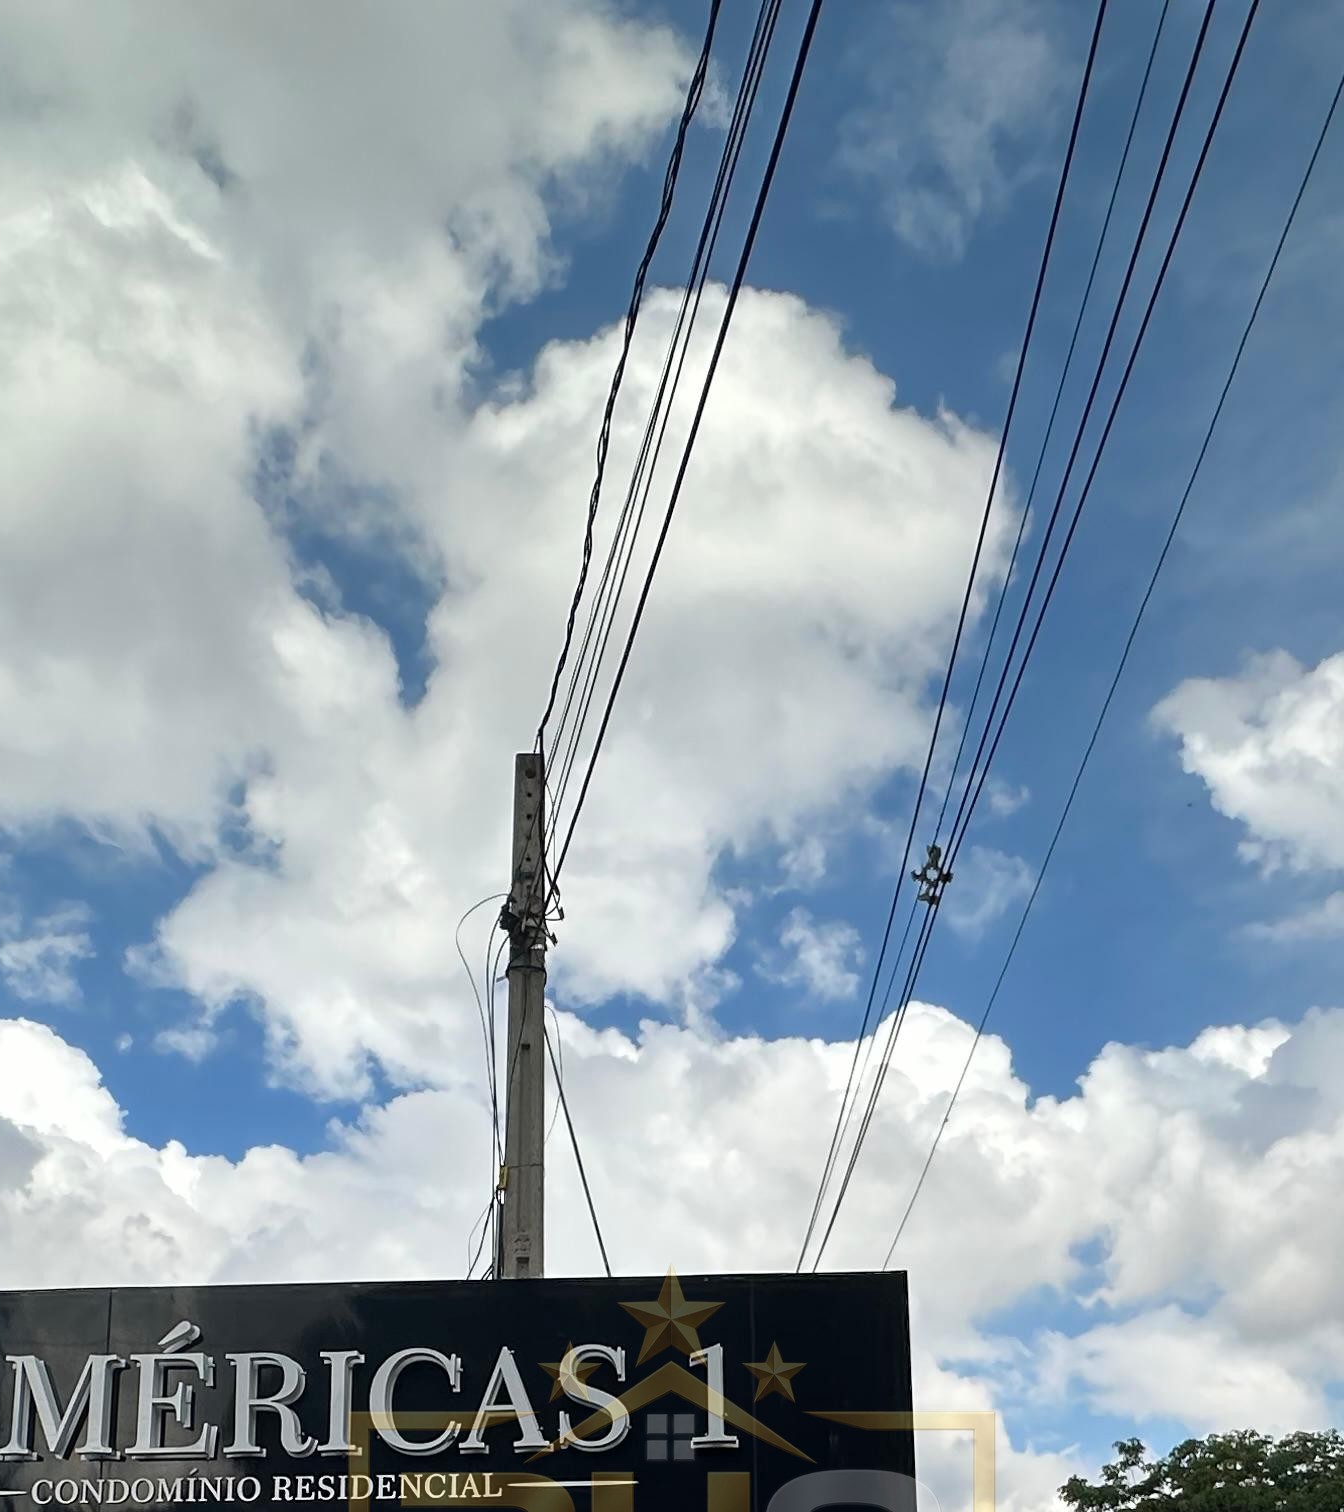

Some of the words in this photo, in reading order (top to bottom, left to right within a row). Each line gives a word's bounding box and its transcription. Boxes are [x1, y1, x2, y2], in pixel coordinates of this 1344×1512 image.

[688, 1342, 740, 1450] 1
[30, 1468, 262, 1505] CONDOMÍNIO
[271, 1472, 504, 1502] RESIDENCIAL
